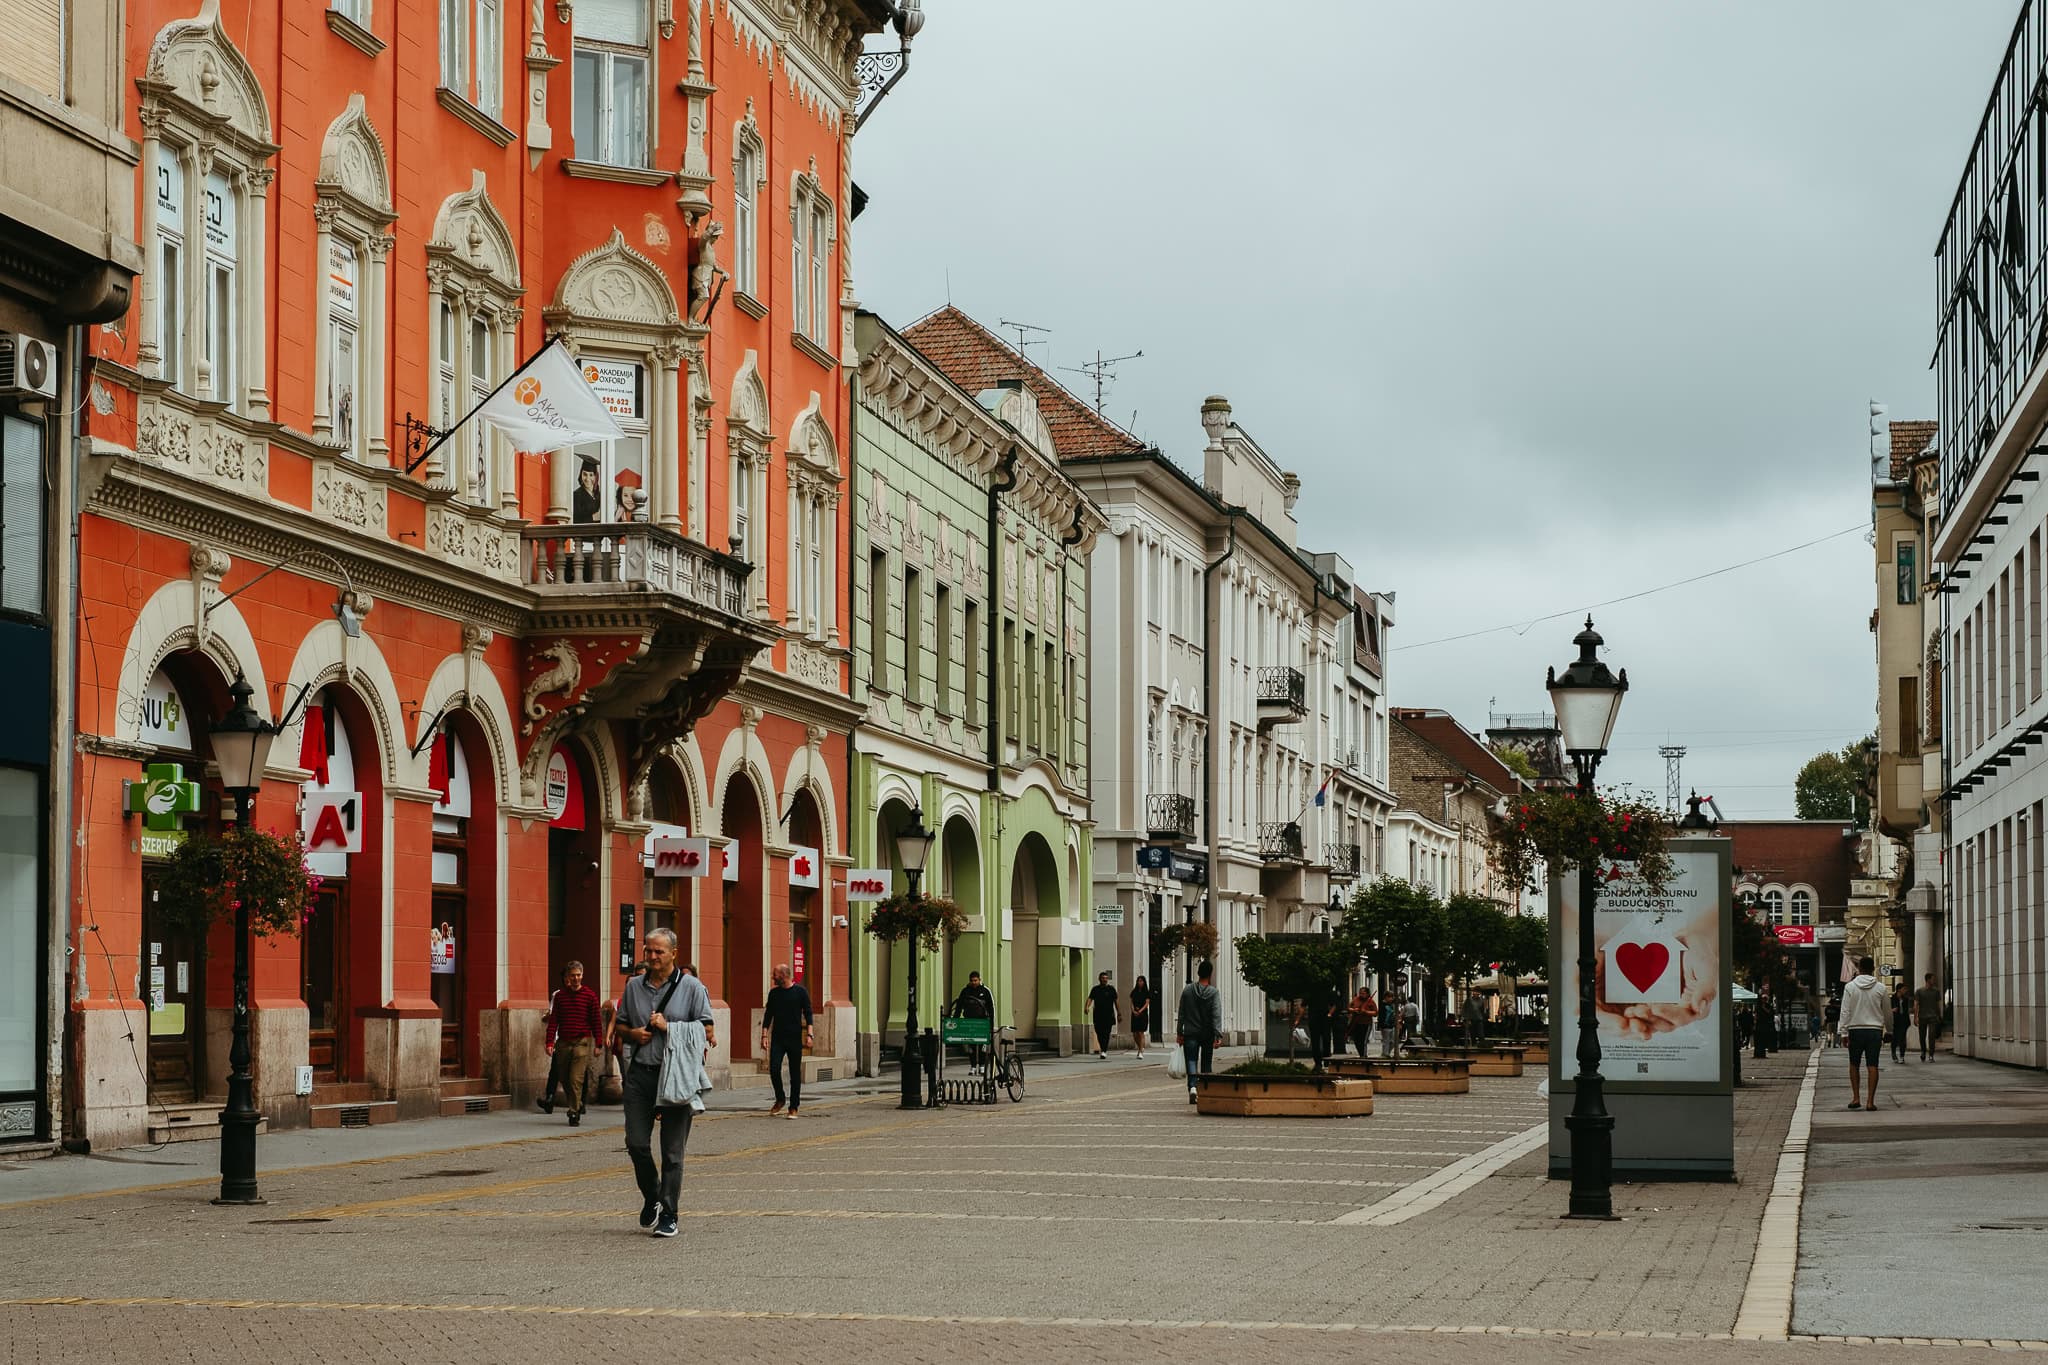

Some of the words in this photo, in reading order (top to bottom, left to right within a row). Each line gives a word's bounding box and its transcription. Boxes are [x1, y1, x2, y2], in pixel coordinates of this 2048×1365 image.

[599, 368, 634, 379] AKADEMIJA
[599, 375, 626, 385] OXFORD
[602, 396, 615, 405] 555
[549, 767, 567, 784] TEXTILE
[549, 785, 565, 797] house
[309, 798, 357, 848] A1
[658, 849, 701, 868] mts
[849, 878, 885, 894] mts
[1608, 898, 1675, 908] BUDUĆNOST!
